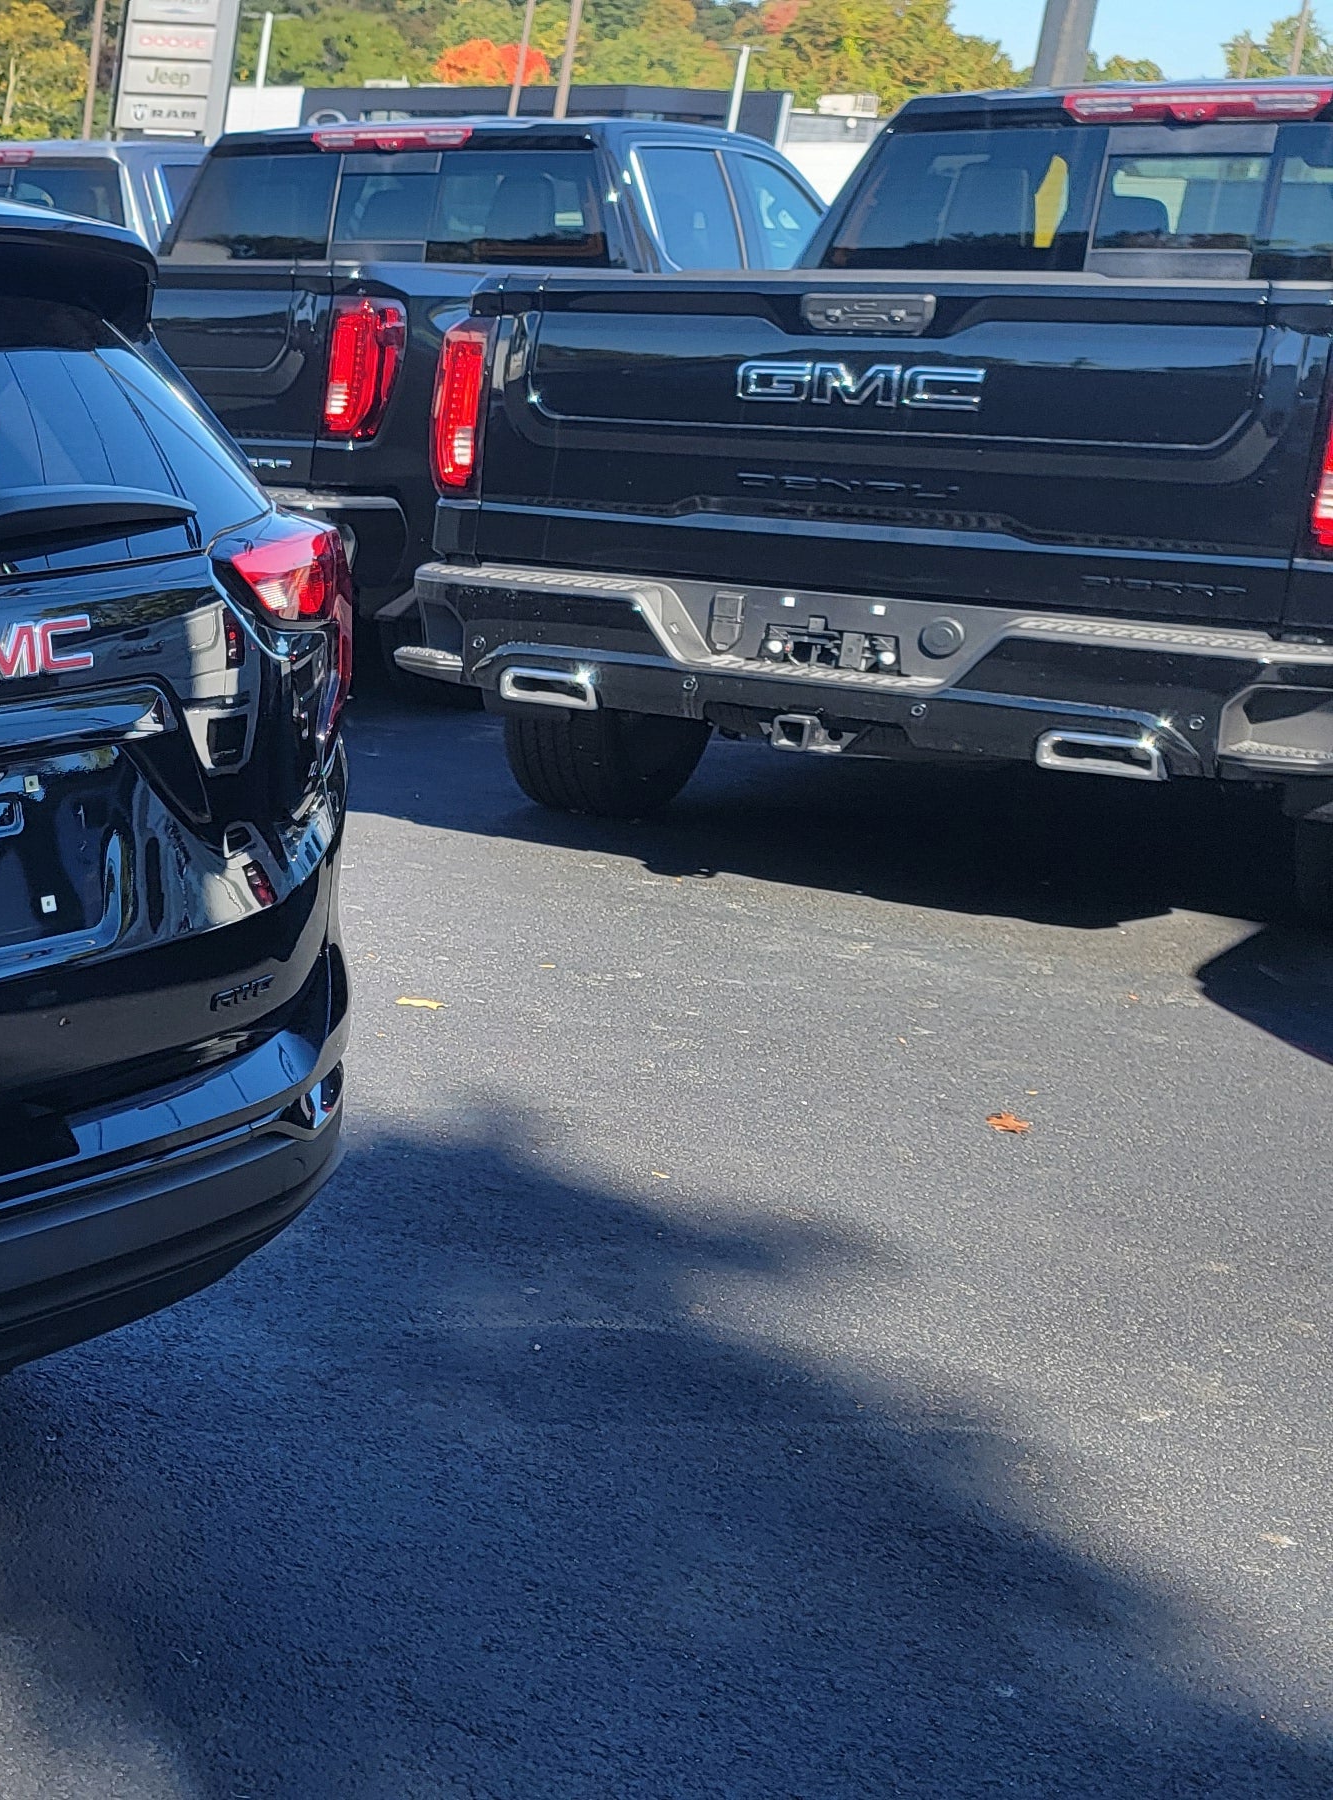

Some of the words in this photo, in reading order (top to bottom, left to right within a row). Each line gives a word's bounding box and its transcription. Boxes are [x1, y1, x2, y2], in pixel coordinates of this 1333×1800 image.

[147, 66, 190, 87] Jeep
[736, 359, 986, 412] GMC
[736, 471, 961, 499] DENALI
[1079, 574, 1249, 598] SIERRA
